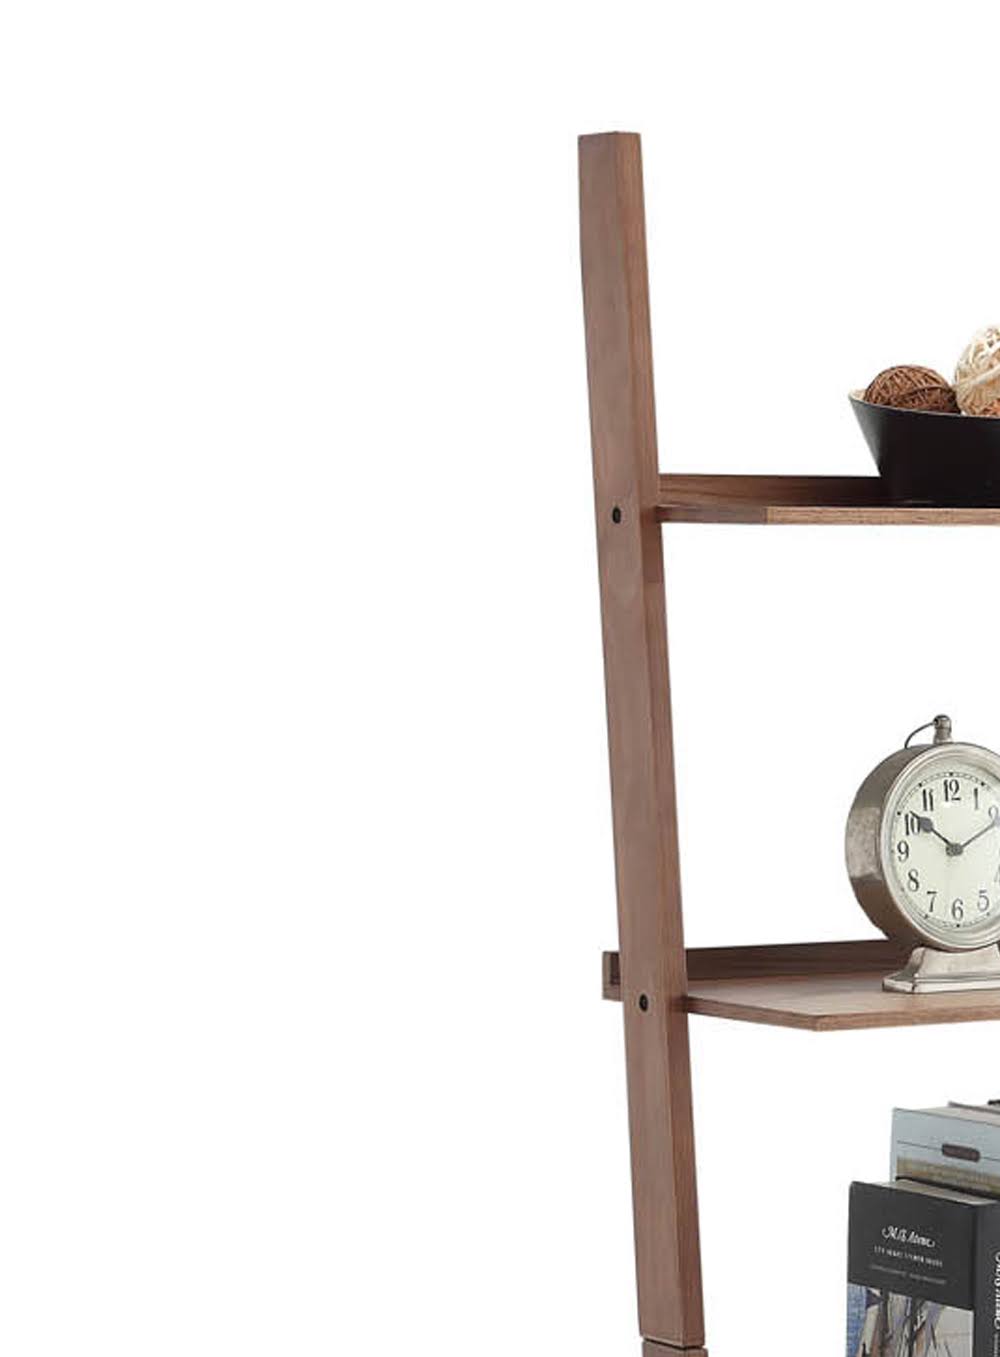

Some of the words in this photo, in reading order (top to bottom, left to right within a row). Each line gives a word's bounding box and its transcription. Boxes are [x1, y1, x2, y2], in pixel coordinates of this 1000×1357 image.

[922, 788, 934, 812] 11
[943, 779, 961, 802] 12
[904, 813, 921, 836] 10
[897, 841, 909, 862] 9
[907, 869, 919, 892] 8
[926, 890, 937, 913] 7
[952, 899, 964, 920] 6
[977, 890, 989, 911] 5
